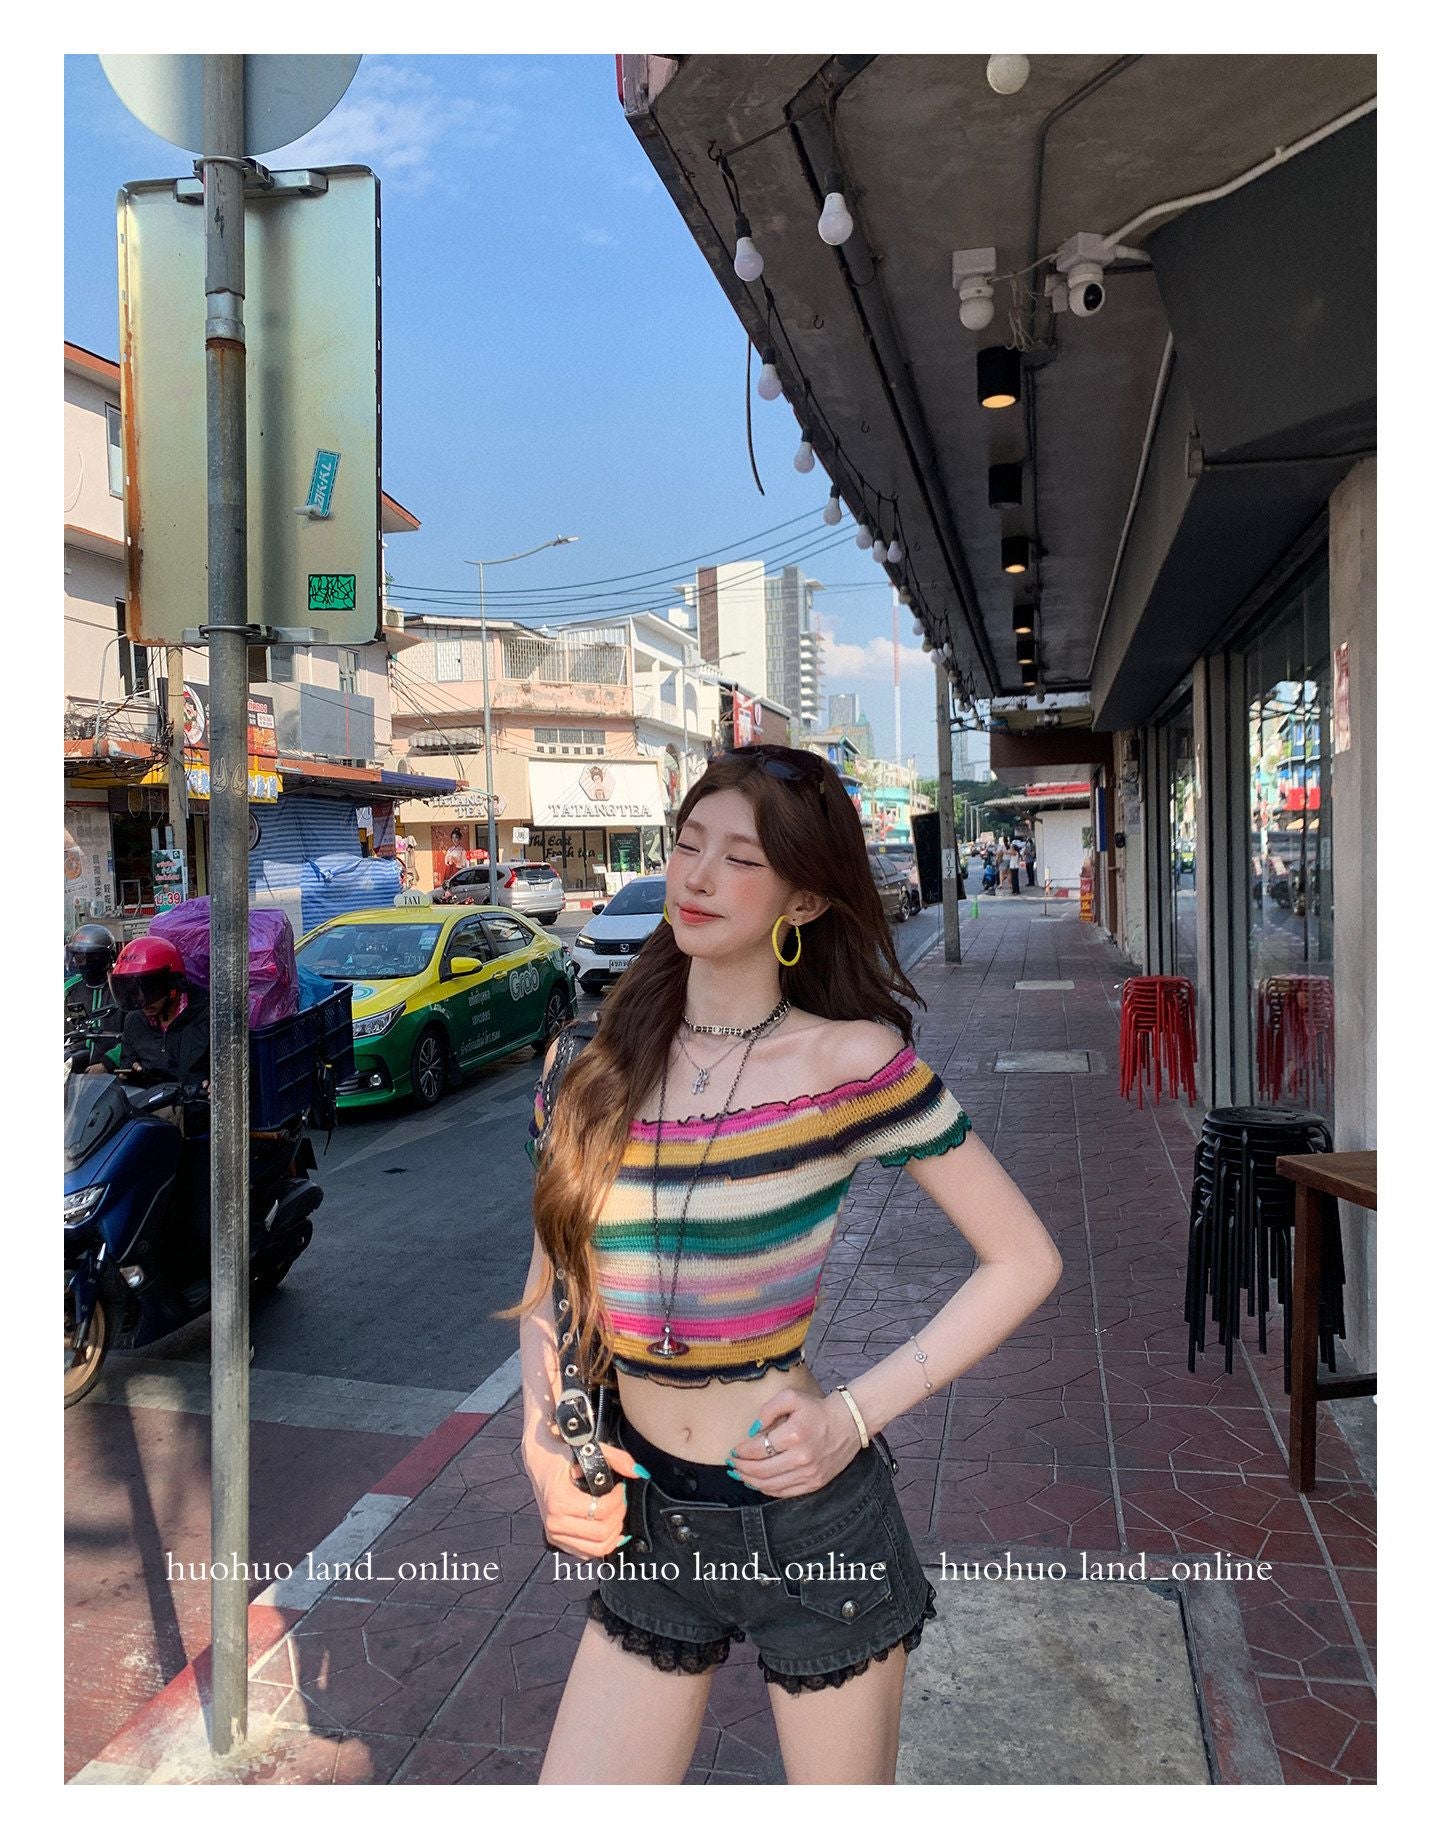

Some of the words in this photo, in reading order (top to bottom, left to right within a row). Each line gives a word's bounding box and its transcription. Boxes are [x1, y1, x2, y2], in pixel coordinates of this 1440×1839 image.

[455, 806, 486, 818] TEA
[403, 895, 421, 905] TAXI
[509, 961, 540, 1001] Grab
